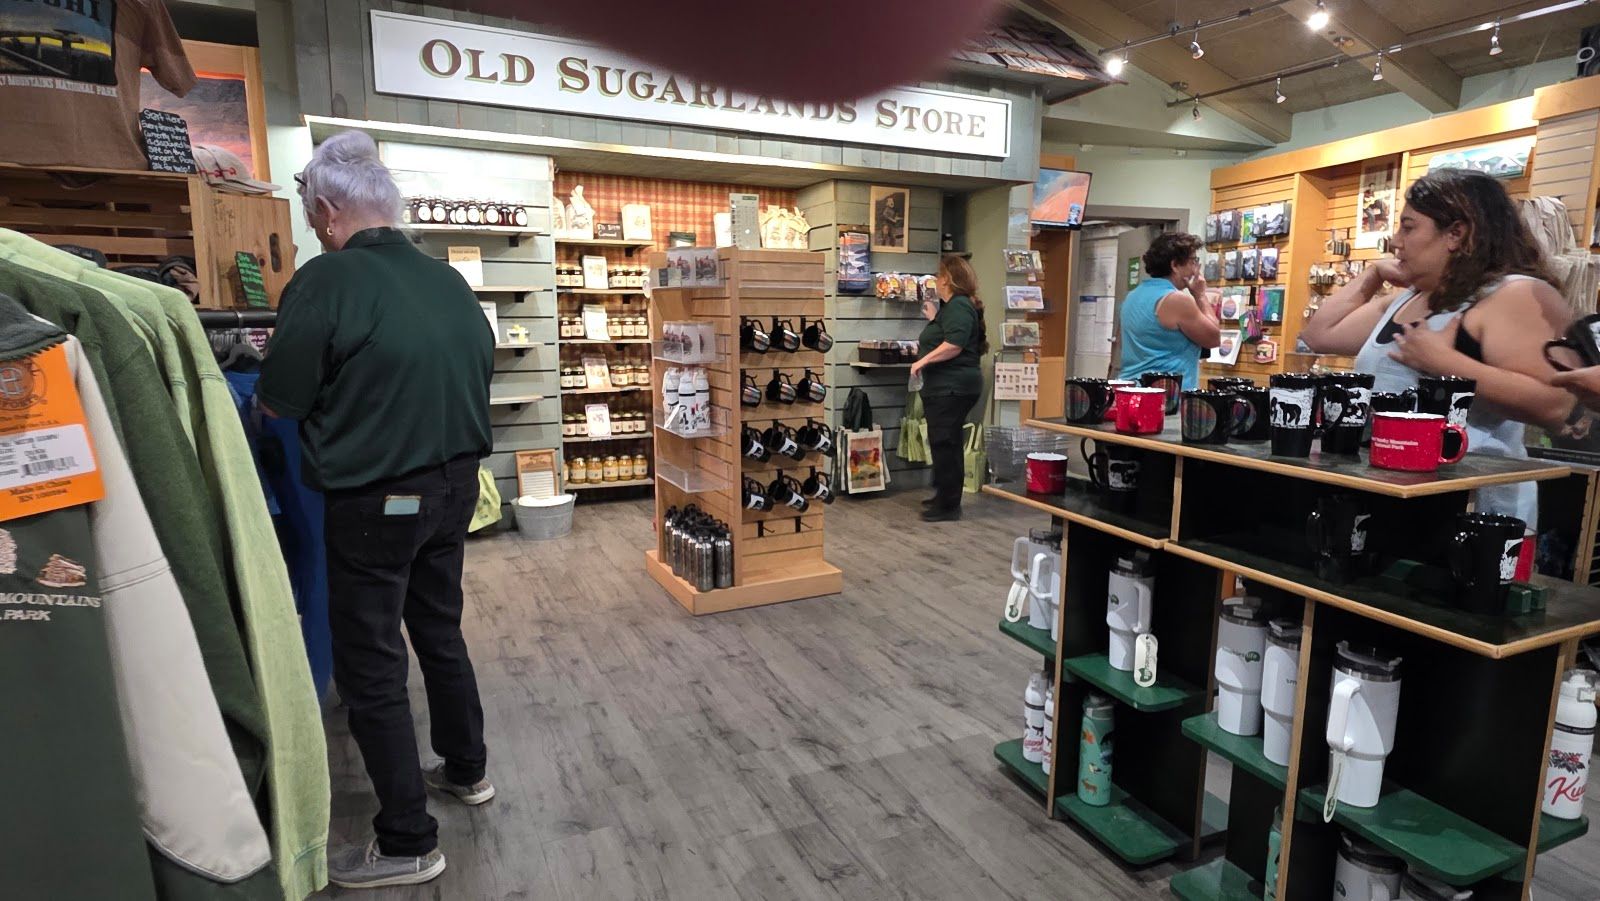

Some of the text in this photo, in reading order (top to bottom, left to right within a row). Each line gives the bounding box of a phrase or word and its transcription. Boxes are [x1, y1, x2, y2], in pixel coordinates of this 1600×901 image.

[95, 85, 118, 98] PARK
[419, 38, 535, 87] OLD
[874, 98, 986, 138] STORE
[4, 609, 51, 621] PARK
